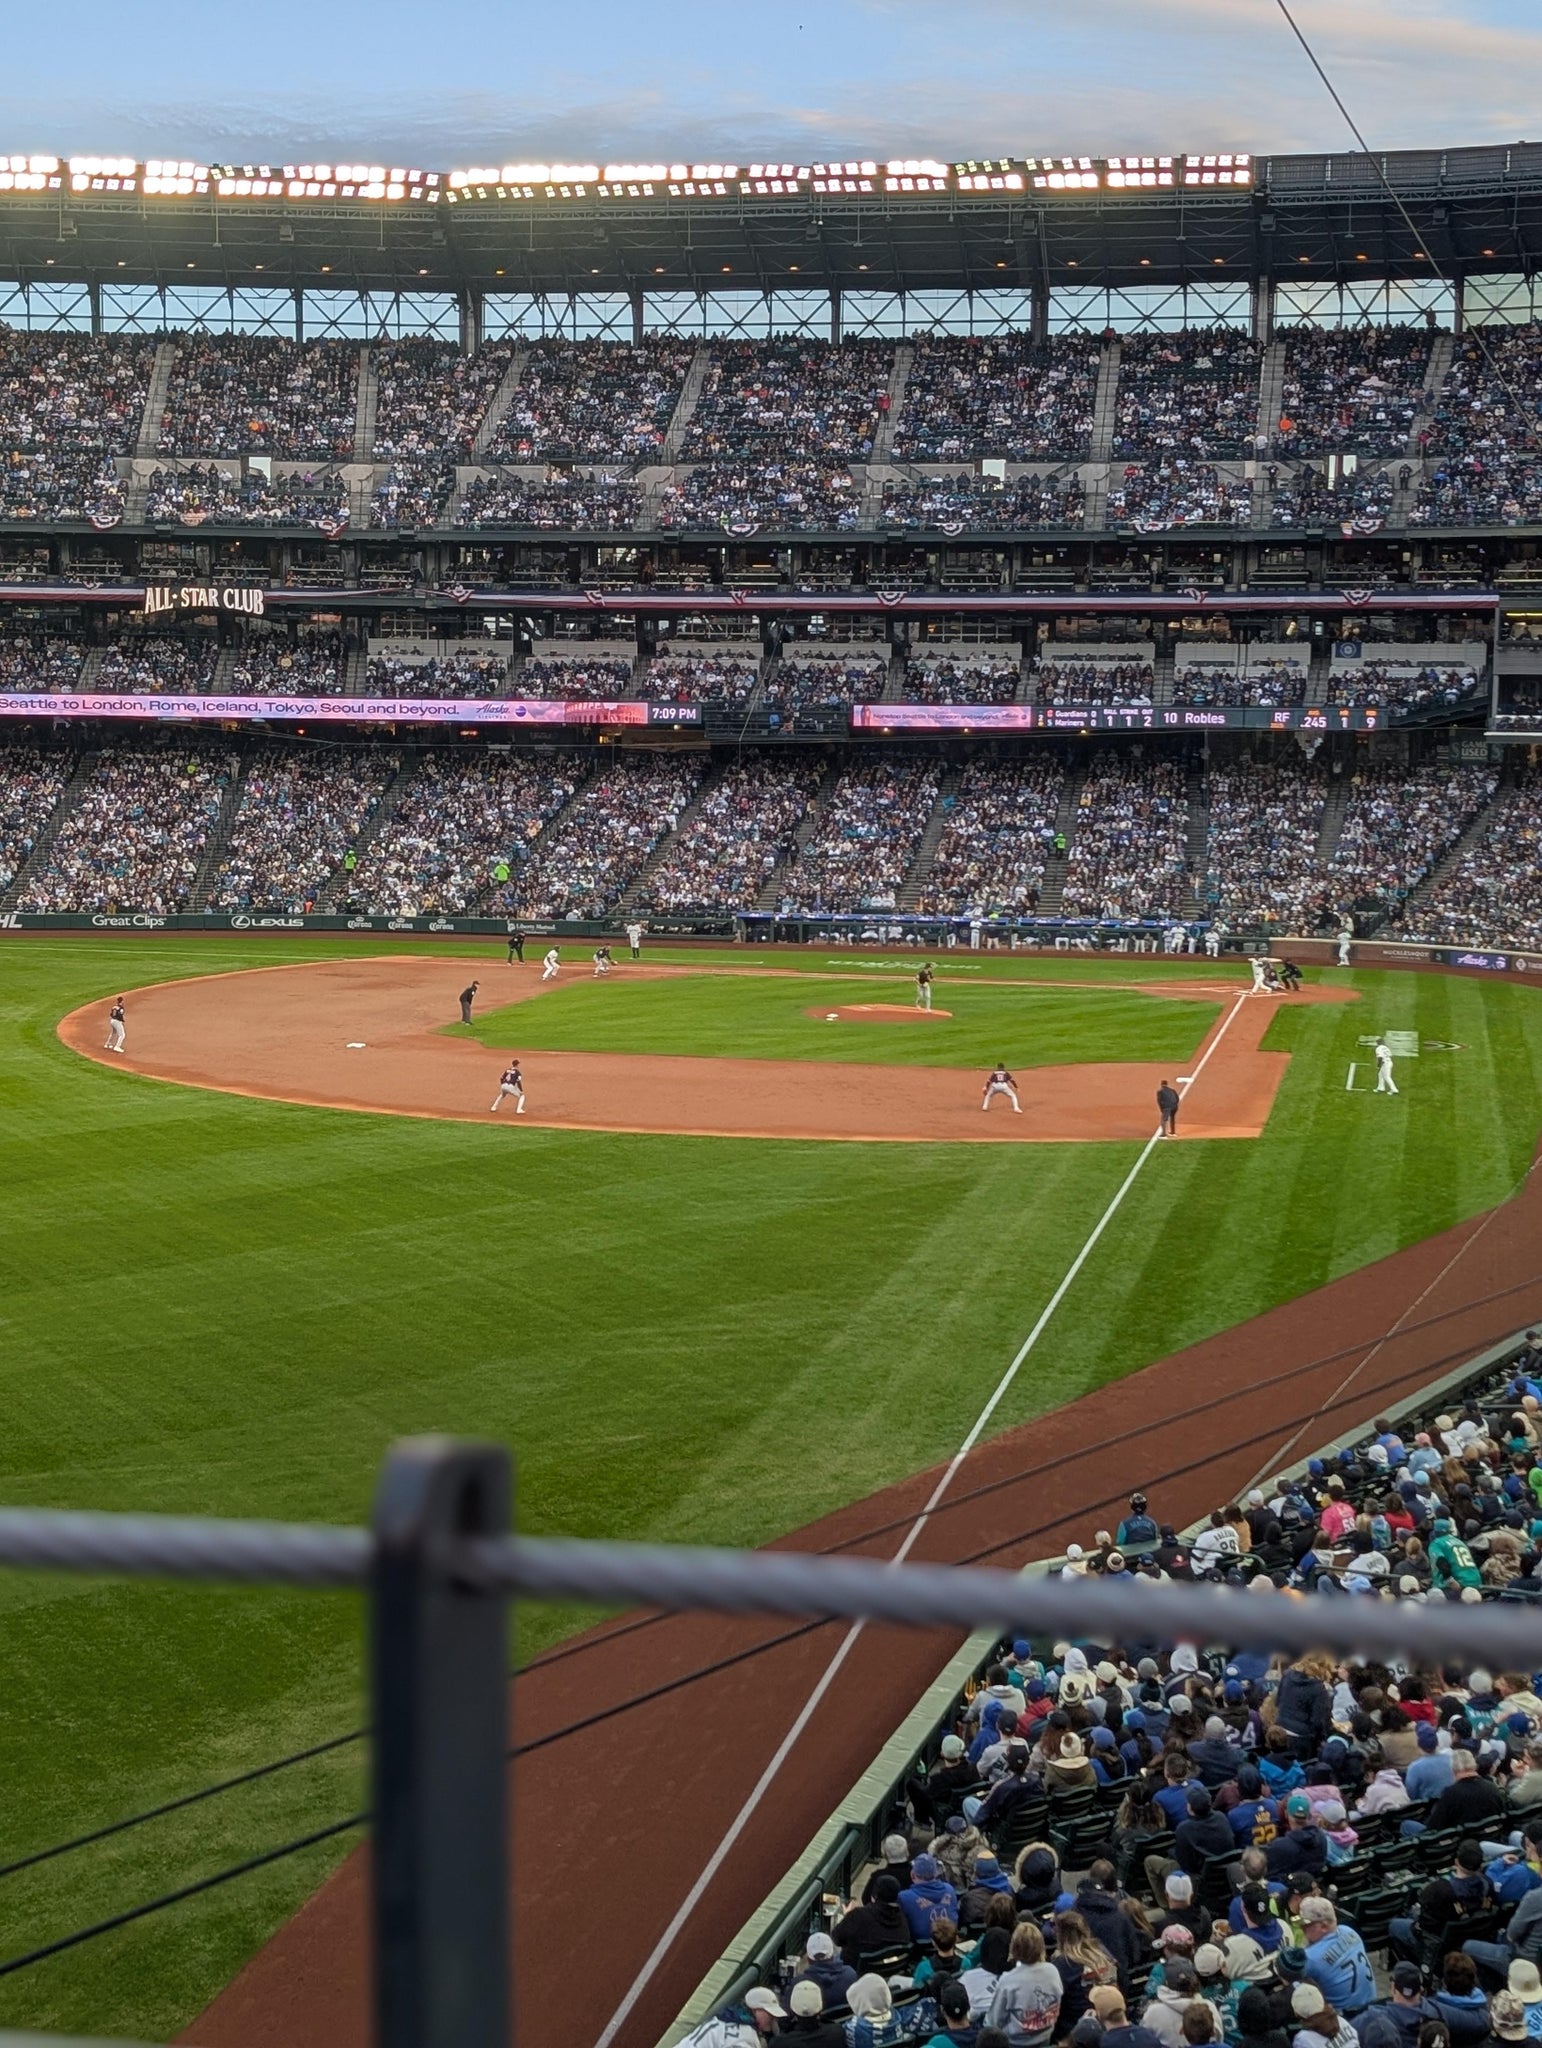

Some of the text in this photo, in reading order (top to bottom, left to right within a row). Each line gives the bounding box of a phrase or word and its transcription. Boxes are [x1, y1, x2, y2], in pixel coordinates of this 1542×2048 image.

[181, 587, 220, 607] STAR
[223, 588, 264, 615] CLUB
[0, 699, 460, 716] Seattle to London, Rome, Iceland, Tokyo, Seoul and beyond.
[652, 708, 697, 720] 7:09 PM
[1055, 710, 1088, 718] Guardians
[1090, 710, 1097, 718] 0
[1163, 712, 1226, 725] 10 Robles
[1274, 712, 1291, 723] RF
[1054, 719, 1085, 727] Mariners
[1090, 719, 1097, 727] 0
[1106, 716, 1153, 727] 1 1 2
[1300, 716, 1376, 728] .245 1 9
[1461, 740, 1488, 749] GAME
[1461, 748, 1488, 757] USED
[91, 914, 167, 928] Great Clips
[251, 918, 304, 927] LEXUS
[347, 919, 373, 930] Corona
[388, 920, 414, 930] Corona
[429, 921, 455, 932] Corona
[1456, 953, 1490, 967] Alaska
[1452, 1546, 1476, 1568] 12
[1224, 1721, 1258, 1748] 24
[1251, 1823, 1277, 1847] 22
[1340, 1951, 1373, 1994] 73
